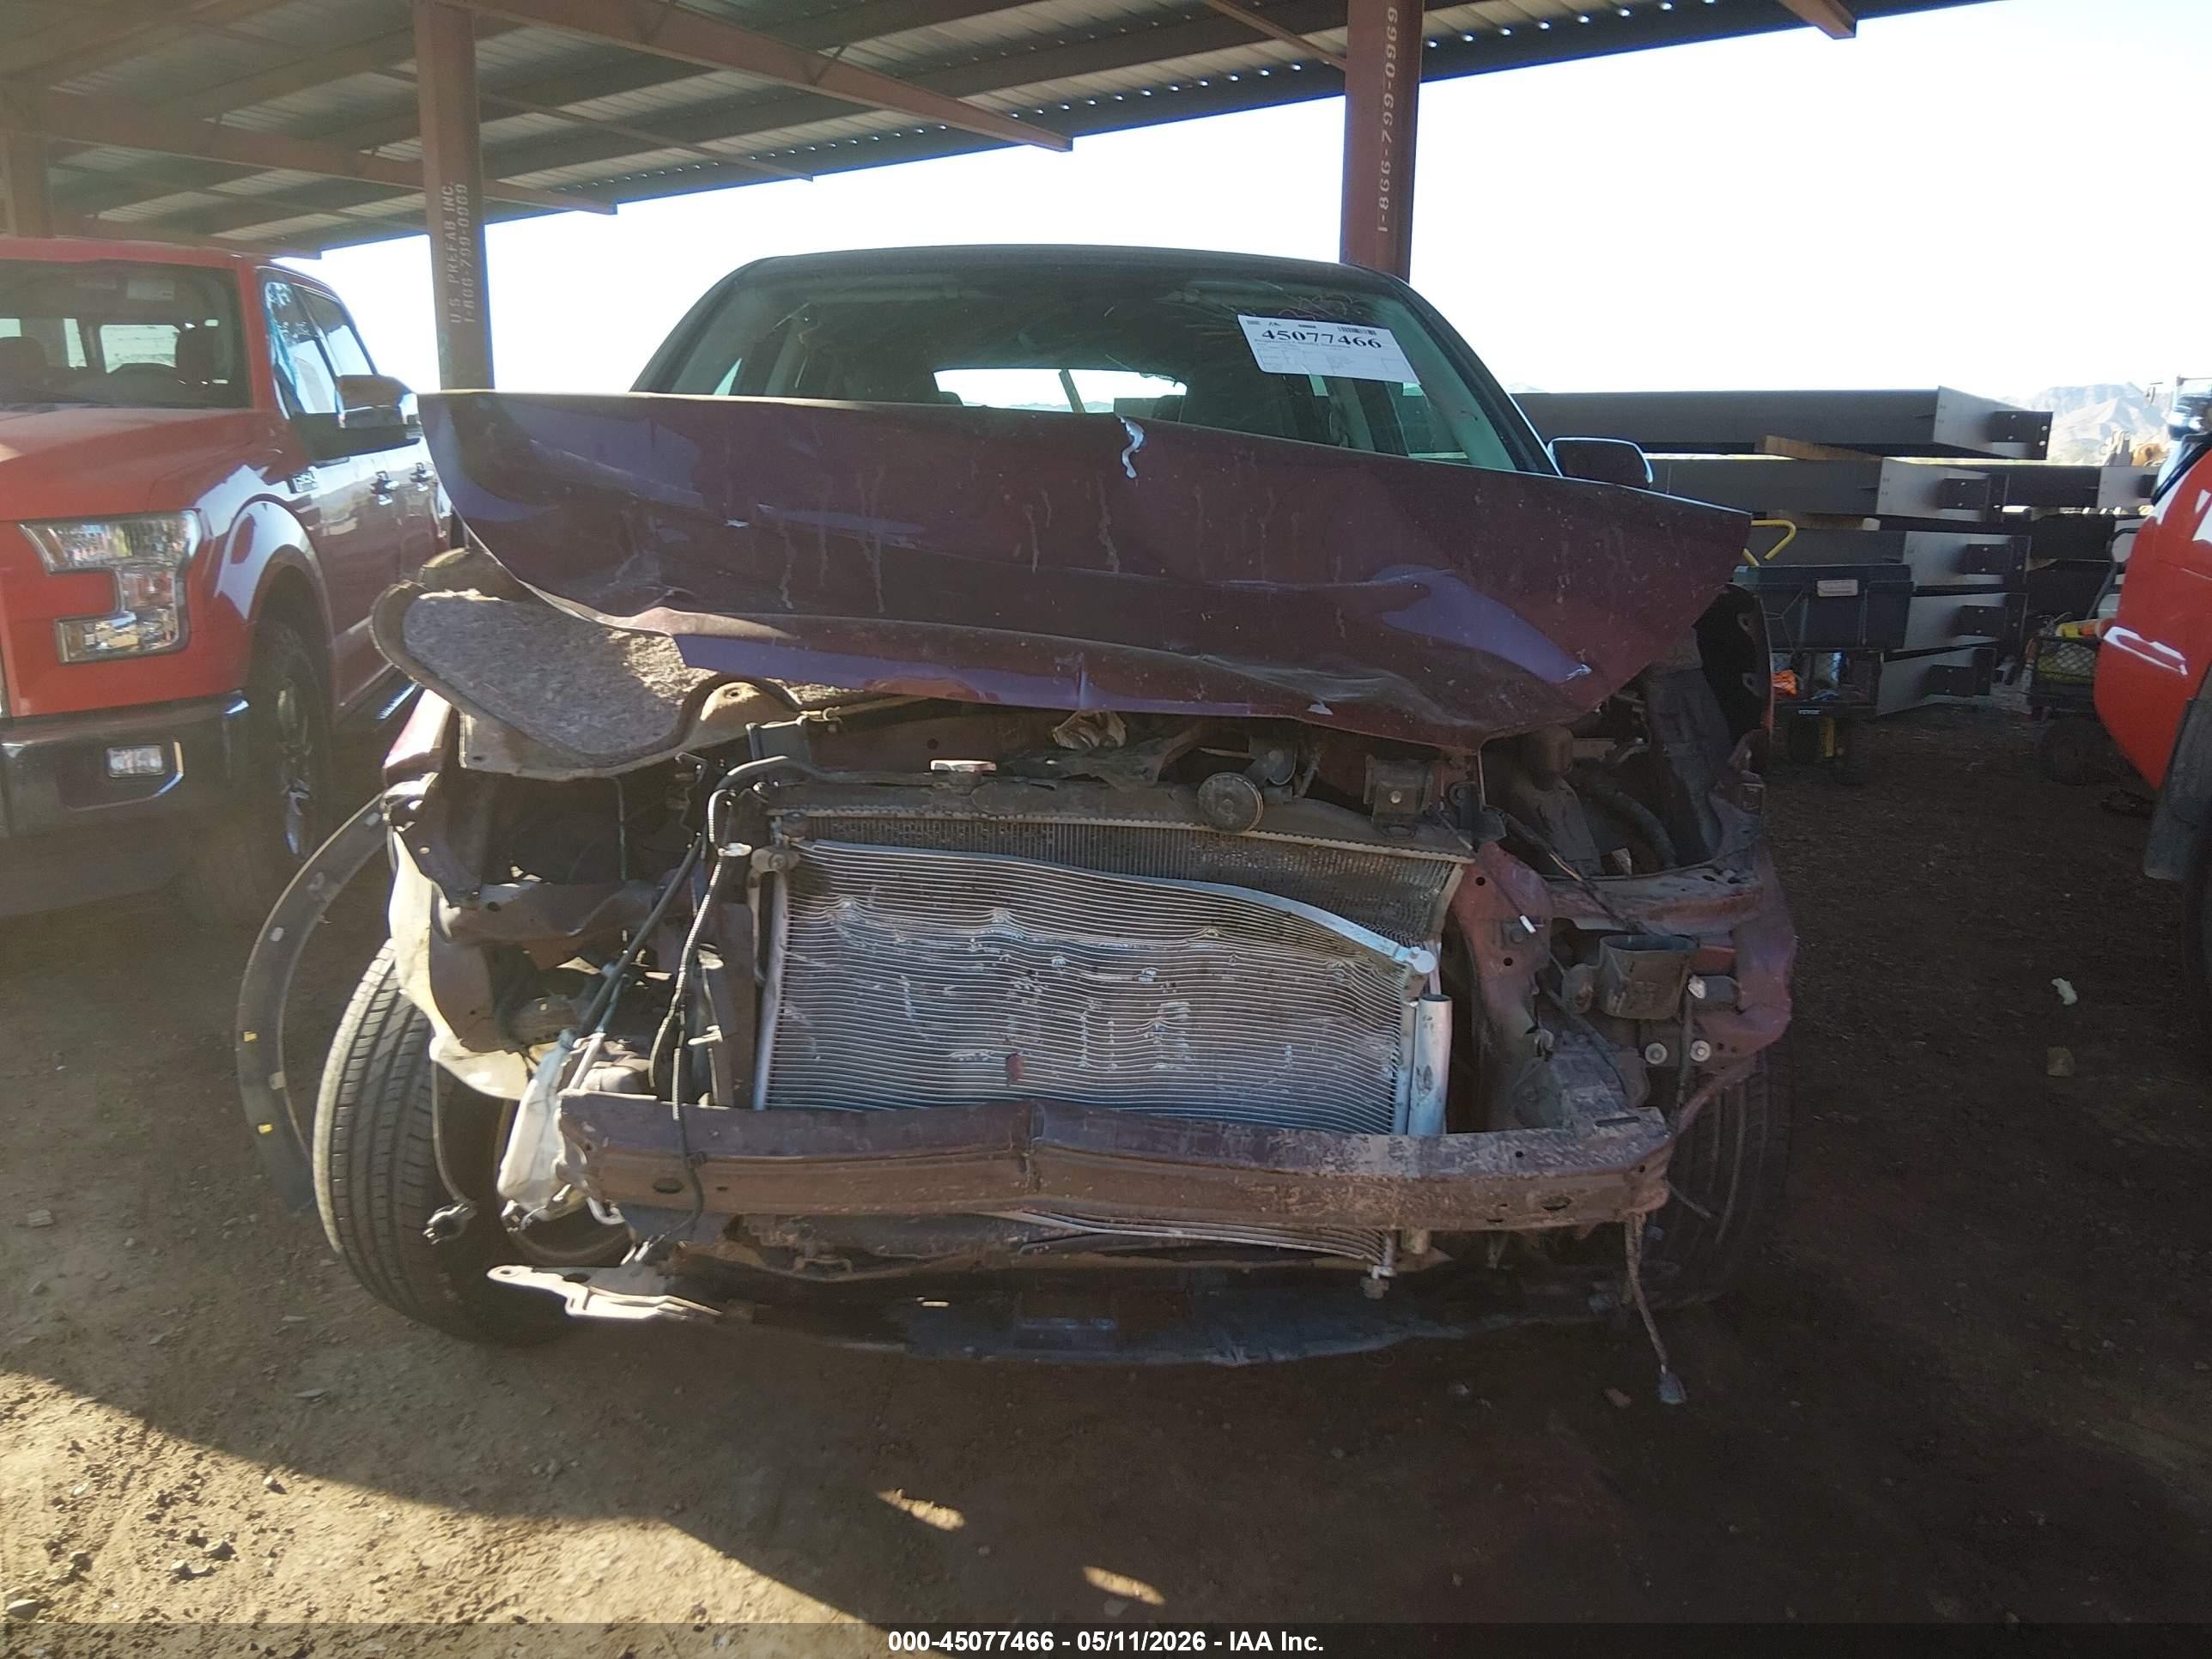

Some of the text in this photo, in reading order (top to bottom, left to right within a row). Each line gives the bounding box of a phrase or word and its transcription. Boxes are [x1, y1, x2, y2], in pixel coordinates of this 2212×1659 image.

[1377, 6, 1398, 233] 1-866-799-0969
[444, 220, 459, 284] PREFAB
[1262, 329, 1382, 349] 45077466
